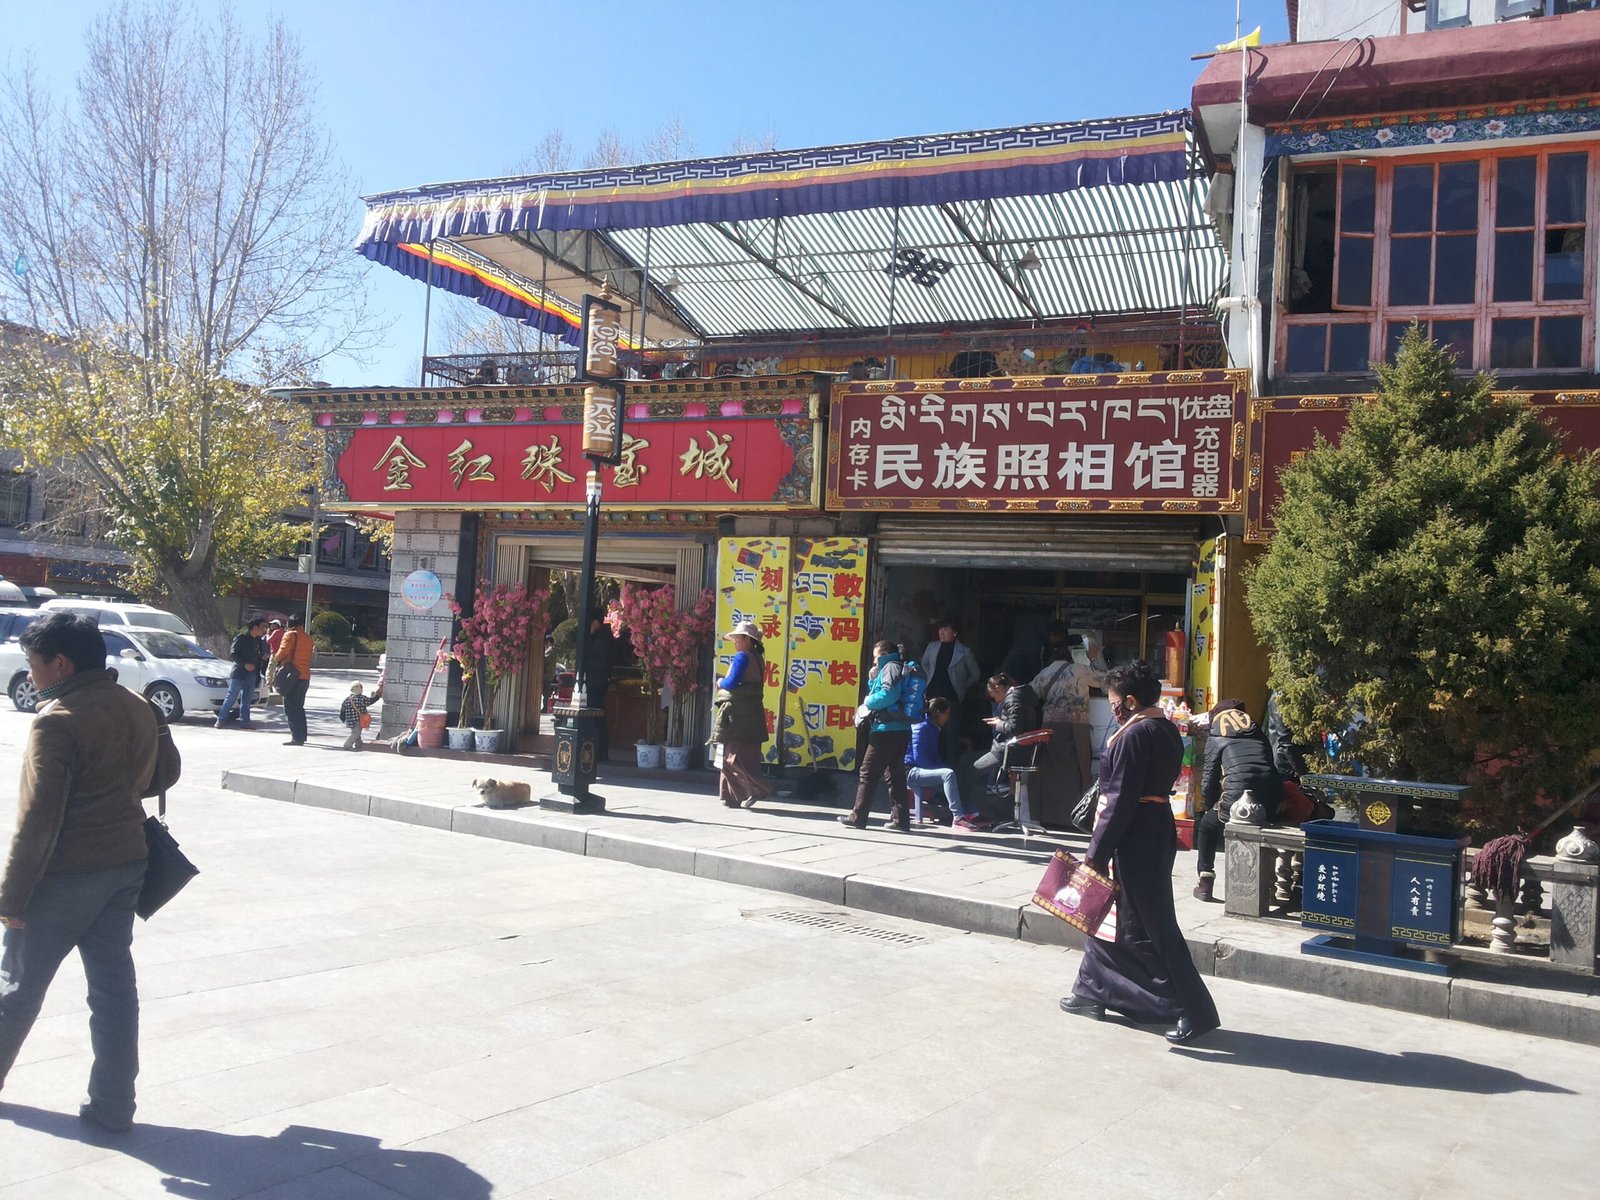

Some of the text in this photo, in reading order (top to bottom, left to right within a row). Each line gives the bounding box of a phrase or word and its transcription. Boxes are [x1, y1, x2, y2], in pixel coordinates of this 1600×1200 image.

[1180, 394, 1233, 420] 优盘
[372, 430, 739, 493] 金红珠宝城
[845, 417, 871, 491] 内存卡
[873, 439, 1187, 491] 民族照相馆
[1190, 425, 1220, 498] 充电器
[826, 572, 864, 731] 数码快印
[1410, 876, 1421, 917] 人人有责
